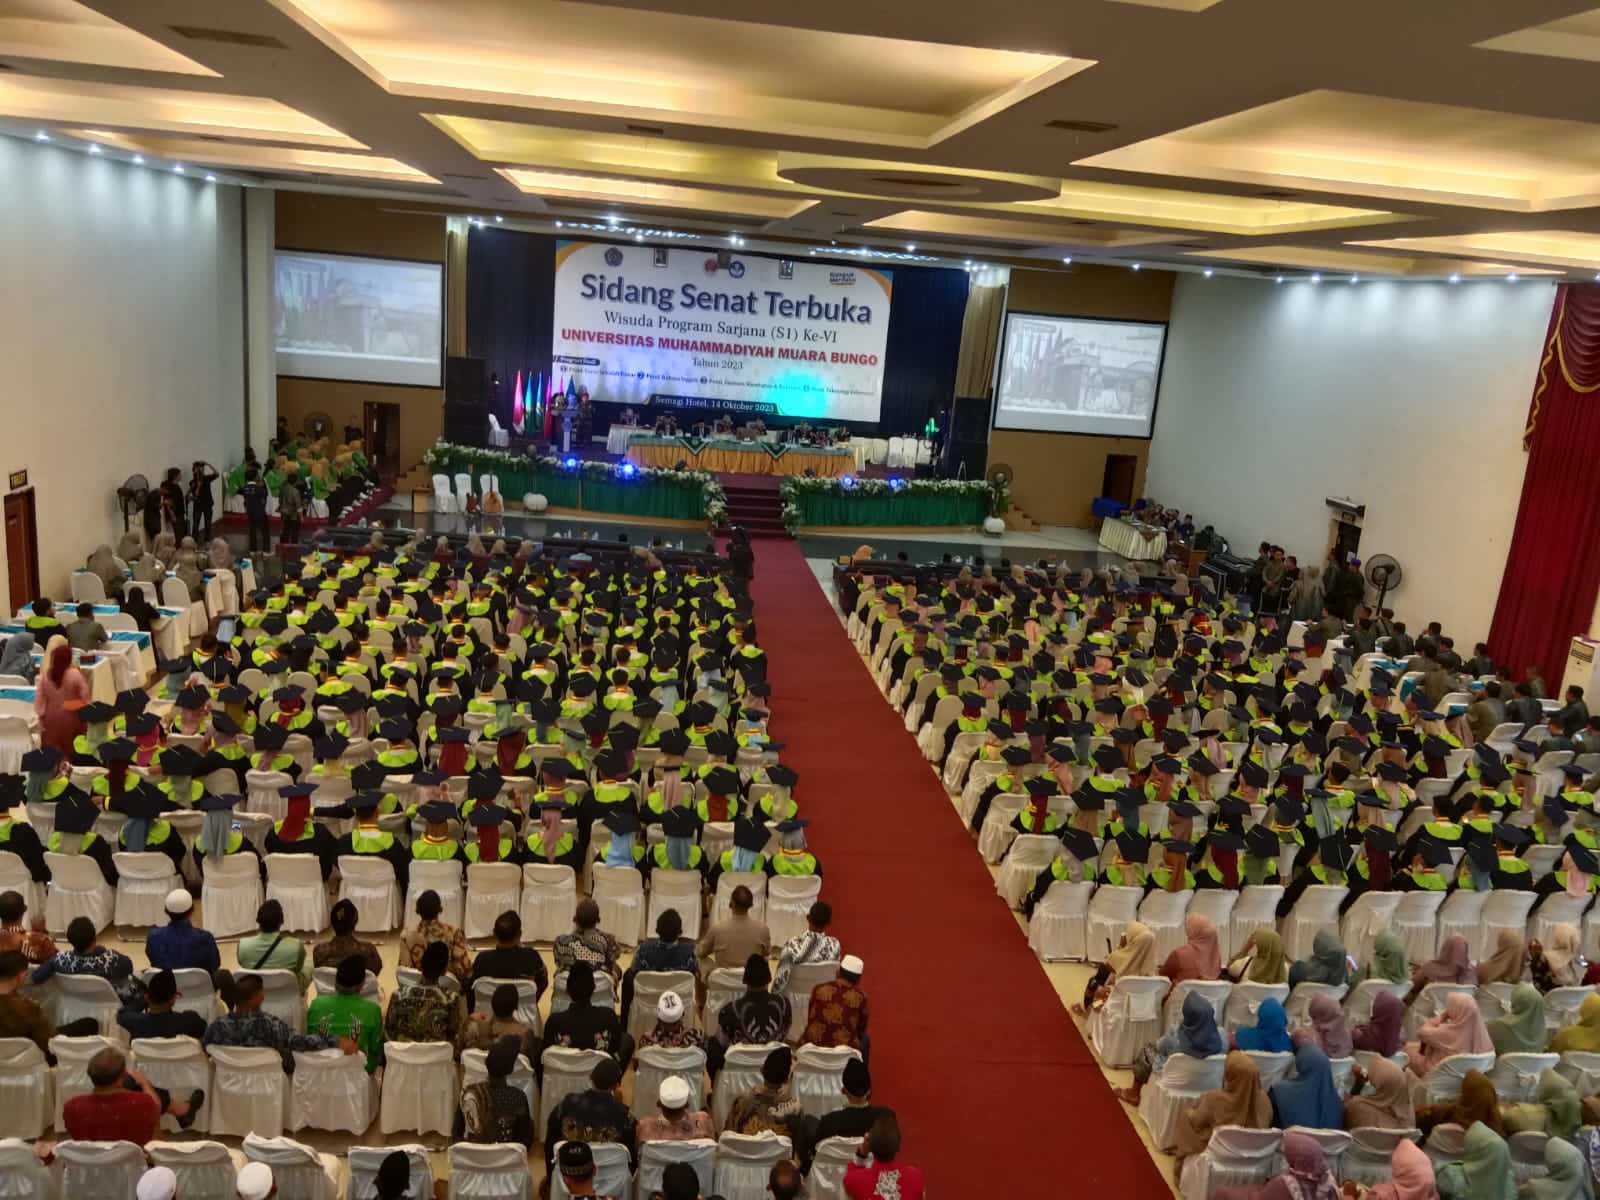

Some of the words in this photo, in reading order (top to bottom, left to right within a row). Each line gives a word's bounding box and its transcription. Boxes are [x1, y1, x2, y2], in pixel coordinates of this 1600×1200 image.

[580, 273, 674, 312] Sidang
[680, 283, 758, 315] Senat
[764, 291, 873, 325] Terbuka
[604, 311, 653, 328] Wisuda
[658, 315, 713, 333] Program
[717, 321, 766, 338] Sarjana
[770, 326, 798, 342] (S1)
[803, 328, 837, 343] Ke-VI
[561, 328, 655, 348] UNIVERSITAS
[658, 337, 774, 358] MUHAMMADIYAH
[778, 347, 826, 362] MUARA
[831, 352, 878, 366] BUNGO
[692, 356, 719, 369] Tahun
[721, 359, 743, 370] 2023
[685, 398, 708, 409] Hotel,
[711, 400, 721, 409] 14
[722, 401, 754, 411] Oktober
[755, 403, 775, 414] 2023
